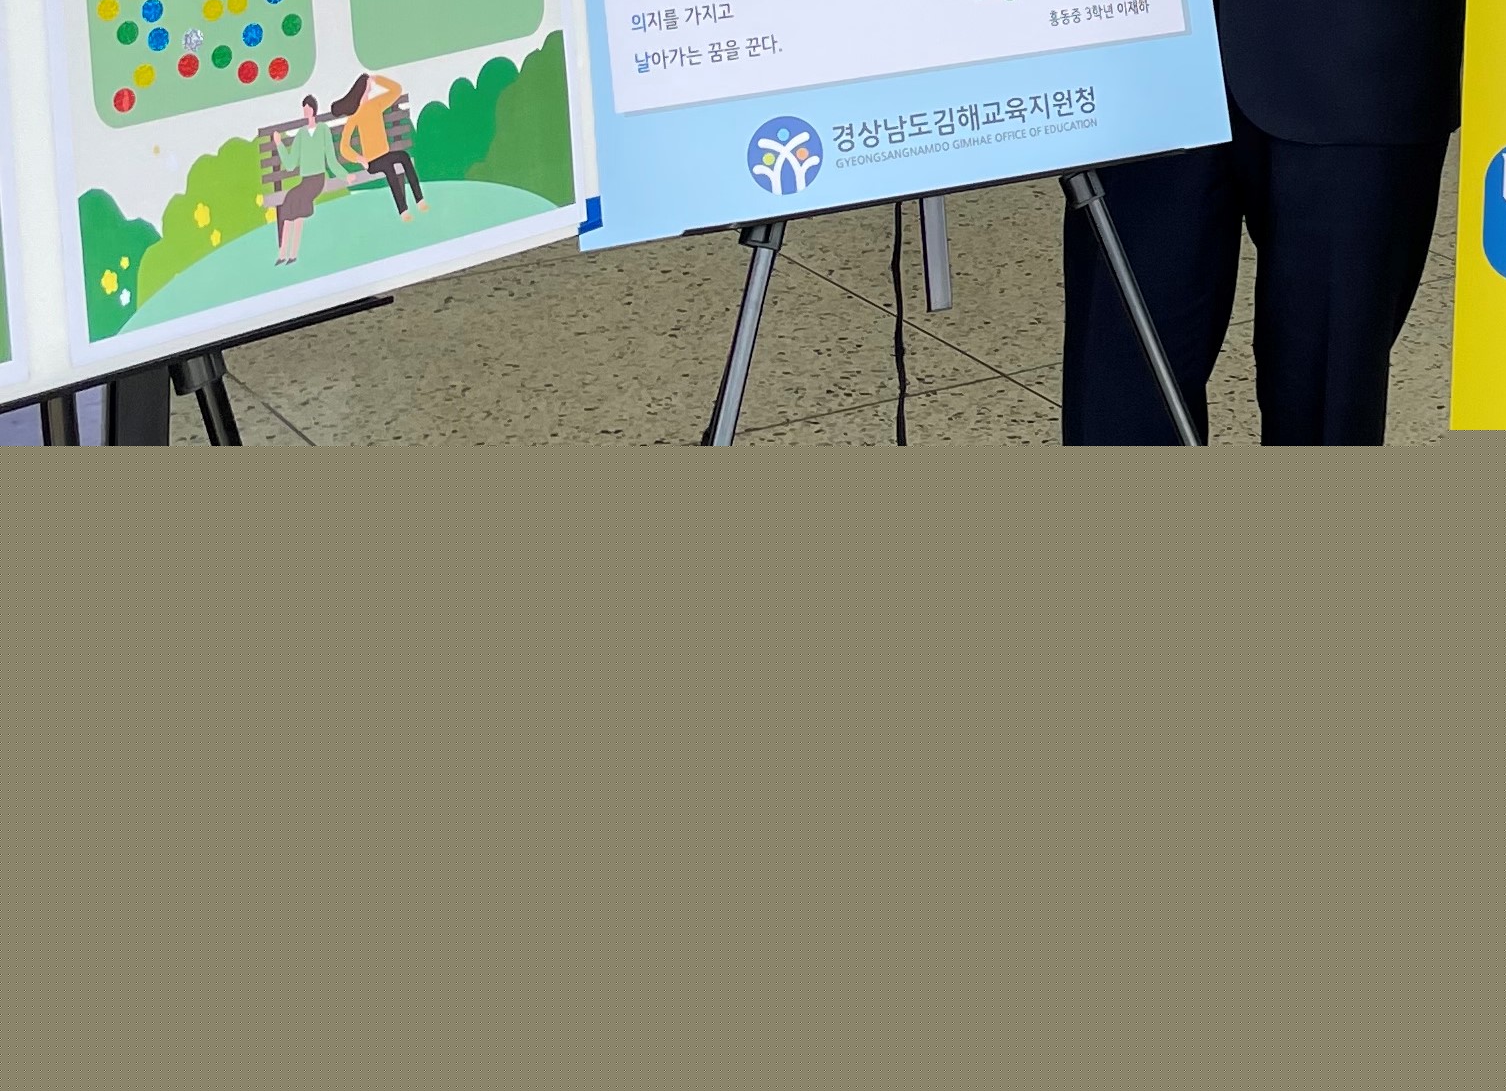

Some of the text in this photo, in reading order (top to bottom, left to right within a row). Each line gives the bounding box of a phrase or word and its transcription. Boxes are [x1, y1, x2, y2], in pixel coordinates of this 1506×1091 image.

[631, 3, 734, 32] 의지를 가지고
[1049, 8, 1081, 26] 홍동중
[1085, 3, 1114, 20] 3학년
[635, 34, 783, 73] 날아가는 꿈을 꾼다.
[832, 86, 1096, 152] 경상남도김해교육지원청
[835, 118, 1098, 168] GYEONGSANGNAMDO GIMHAE OFFICE OF EDUCATION
